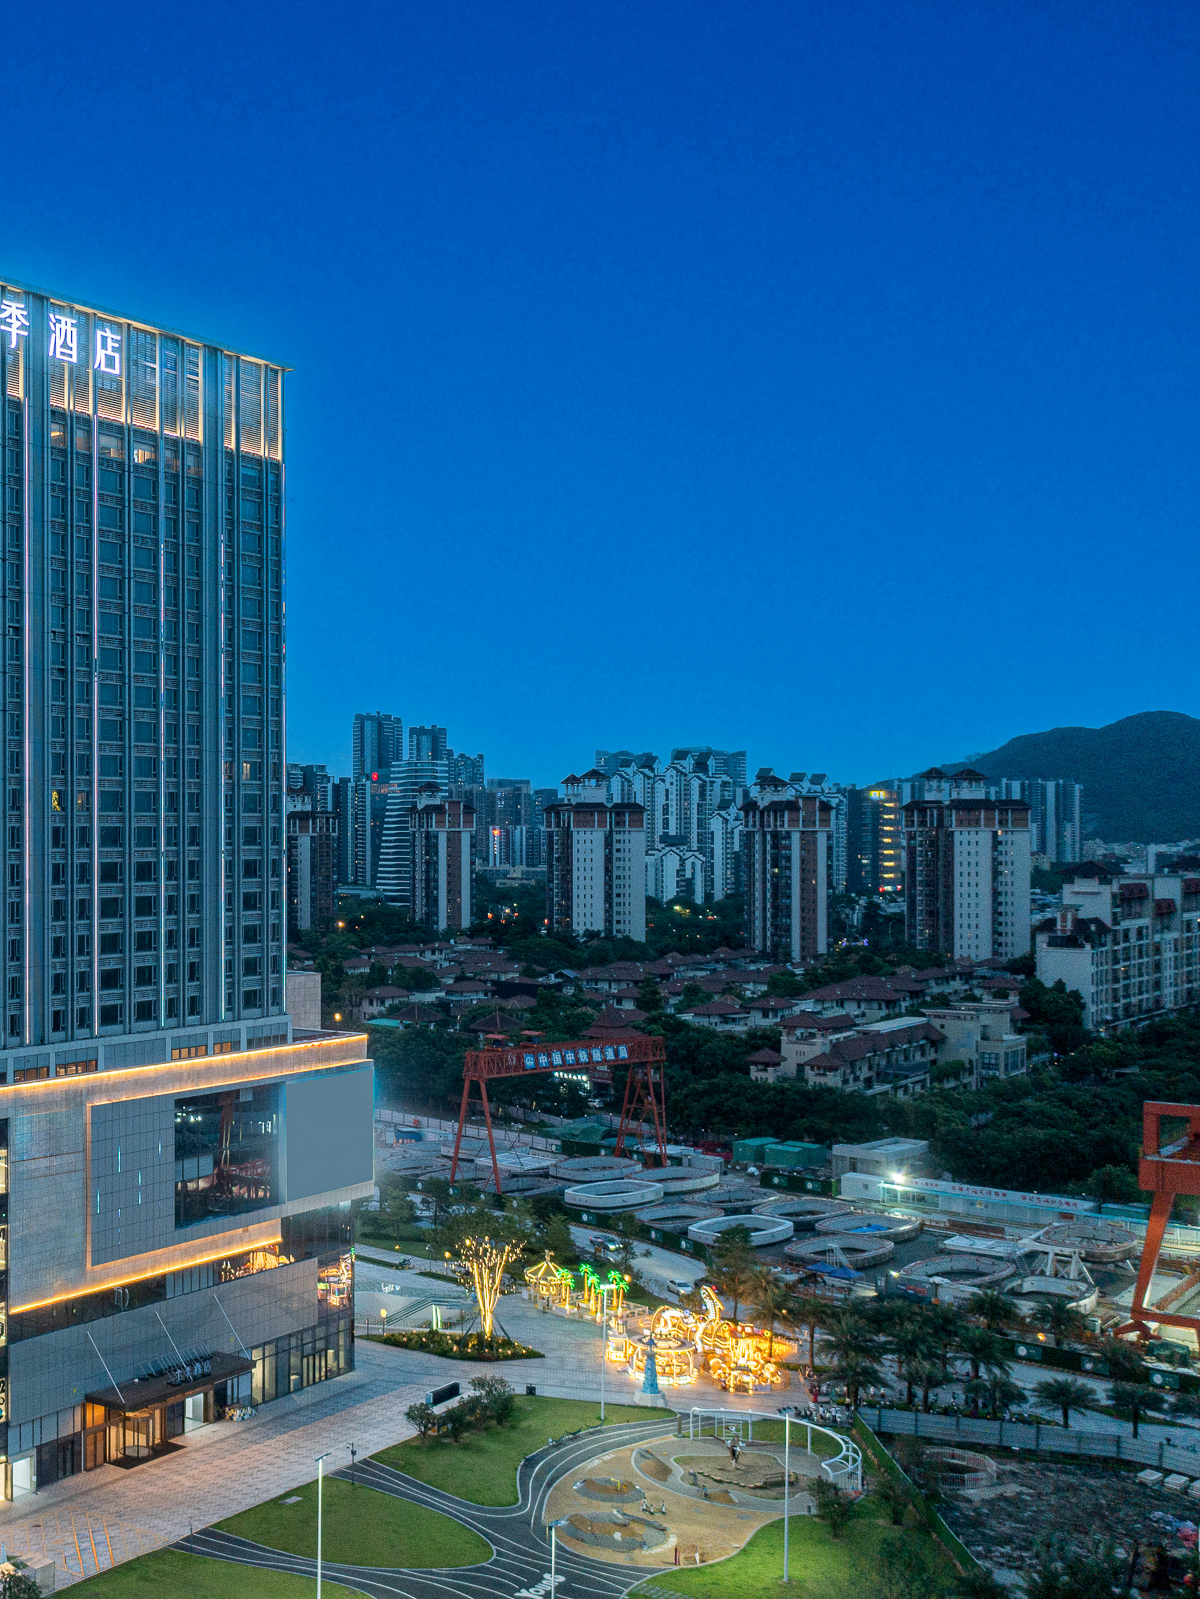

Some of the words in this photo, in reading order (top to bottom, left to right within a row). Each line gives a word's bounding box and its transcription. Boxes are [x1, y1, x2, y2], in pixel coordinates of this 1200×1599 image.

[538, 1045, 628, 1068] 中国中铁隧道局
